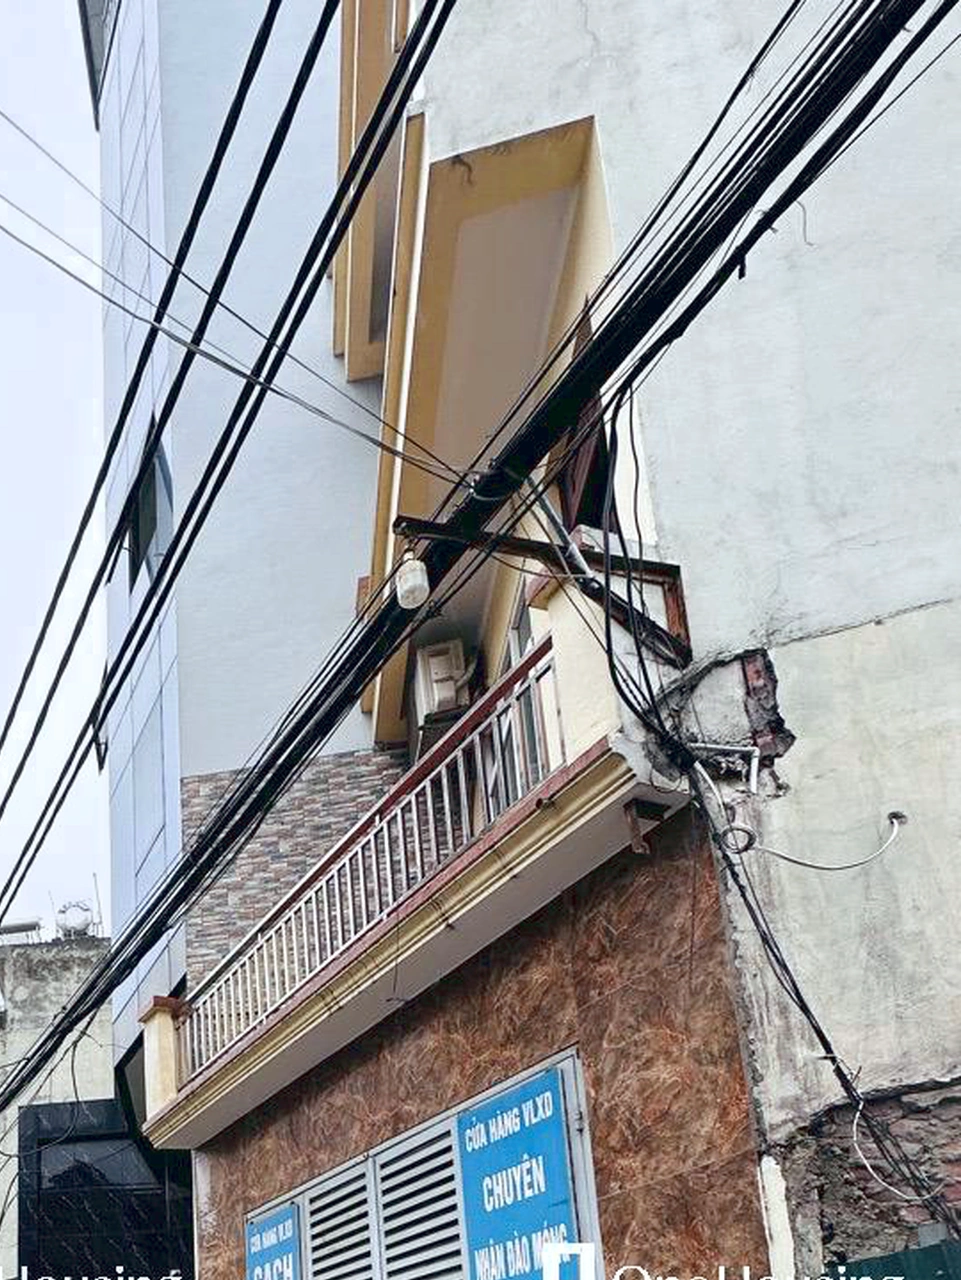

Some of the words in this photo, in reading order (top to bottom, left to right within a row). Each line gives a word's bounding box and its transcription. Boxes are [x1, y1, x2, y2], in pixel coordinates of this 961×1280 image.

[464, 1116, 488, 1152] CỬA
[489, 1107, 521, 1143] HÀNG
[522, 1090, 554, 1127] VLXD
[482, 1152, 547, 1213] CHUYÊN
